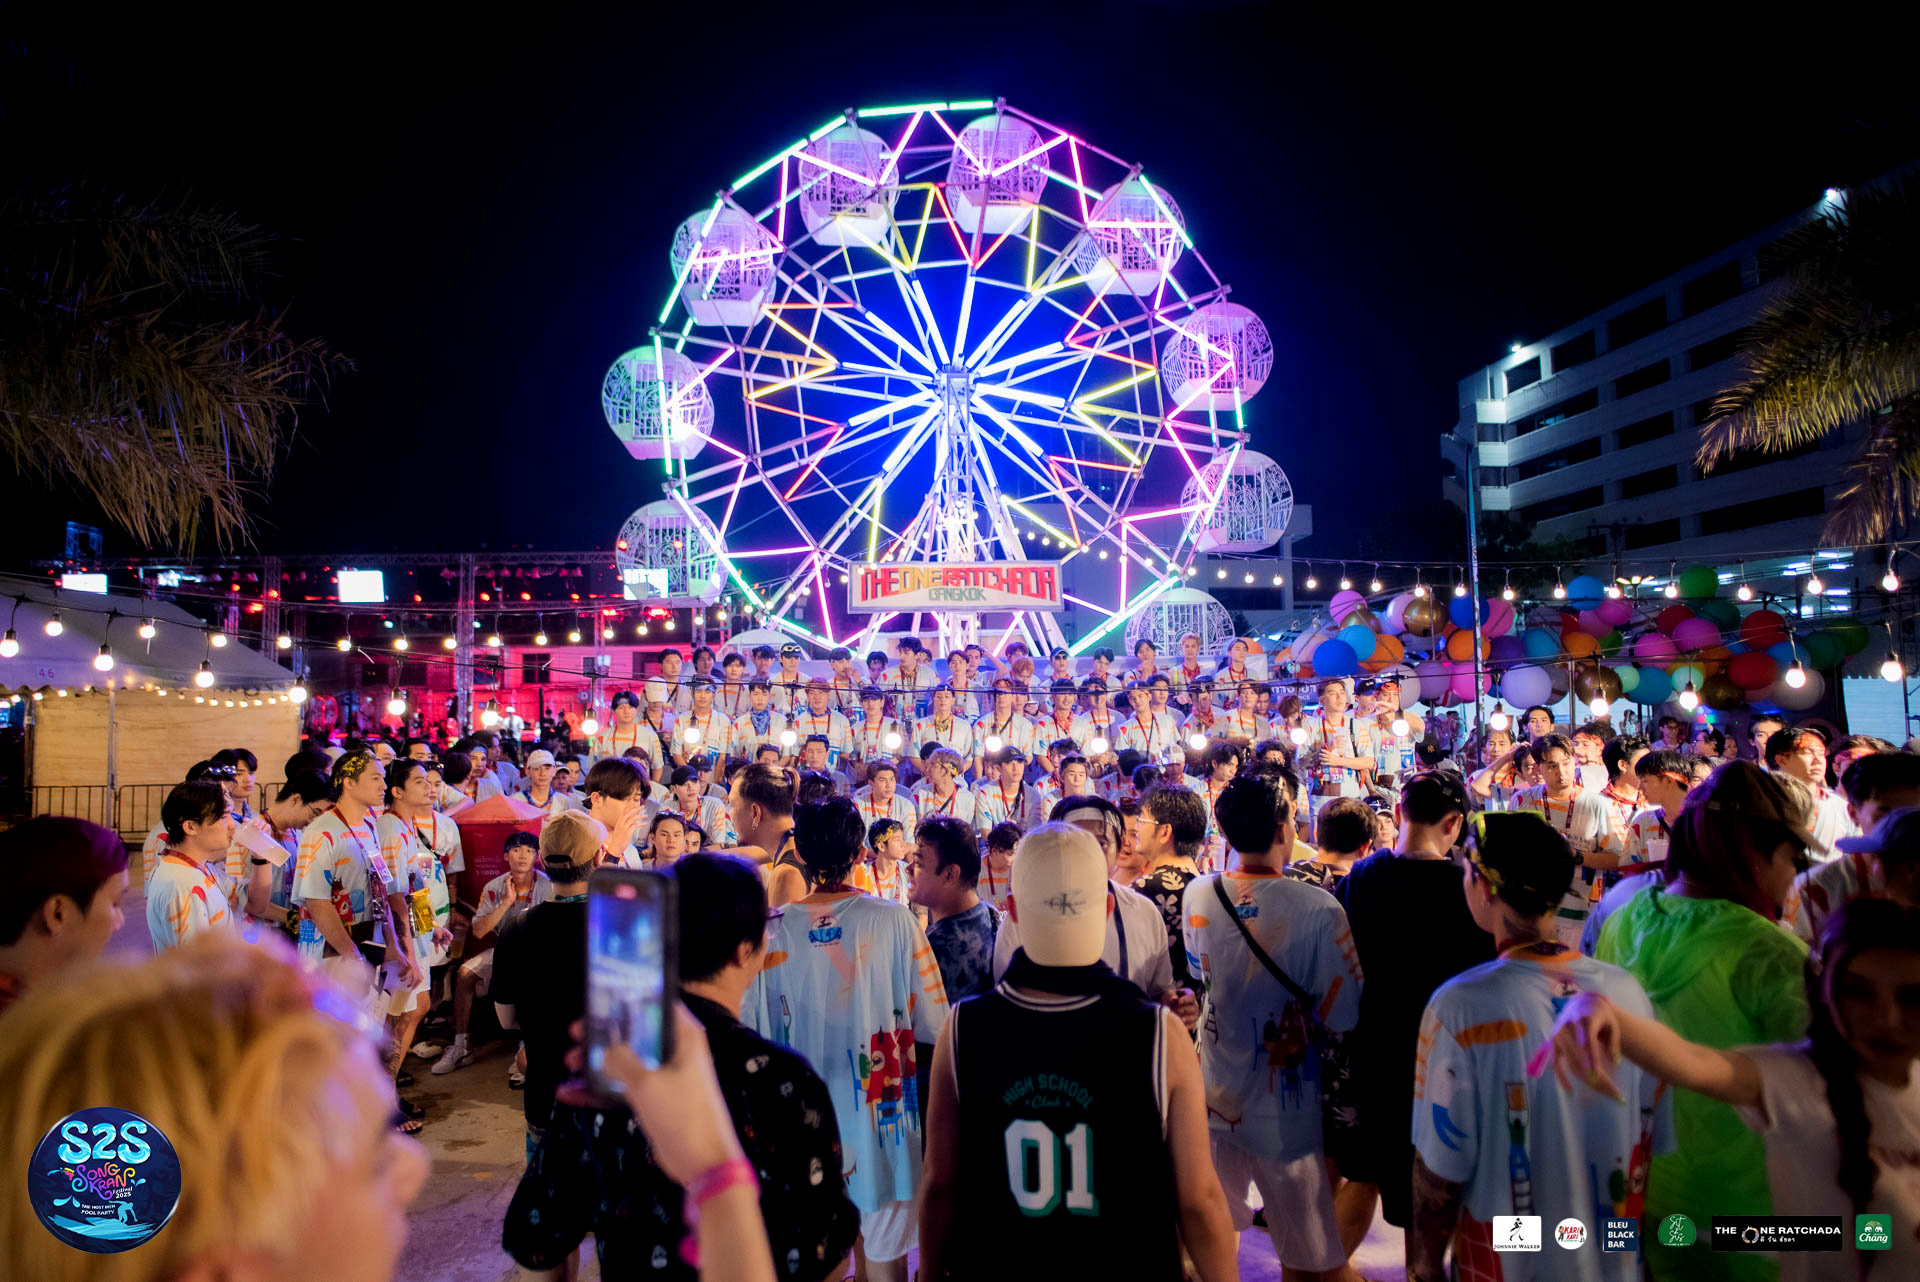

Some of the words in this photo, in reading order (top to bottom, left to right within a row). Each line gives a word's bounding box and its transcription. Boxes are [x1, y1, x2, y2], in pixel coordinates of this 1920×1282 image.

[928, 587, 987, 601] BANGKOK
[1002, 1075, 1034, 1106] HIGH
[1038, 1073, 1094, 1111] SCHOOL
[1004, 1118, 1099, 1217] 01
